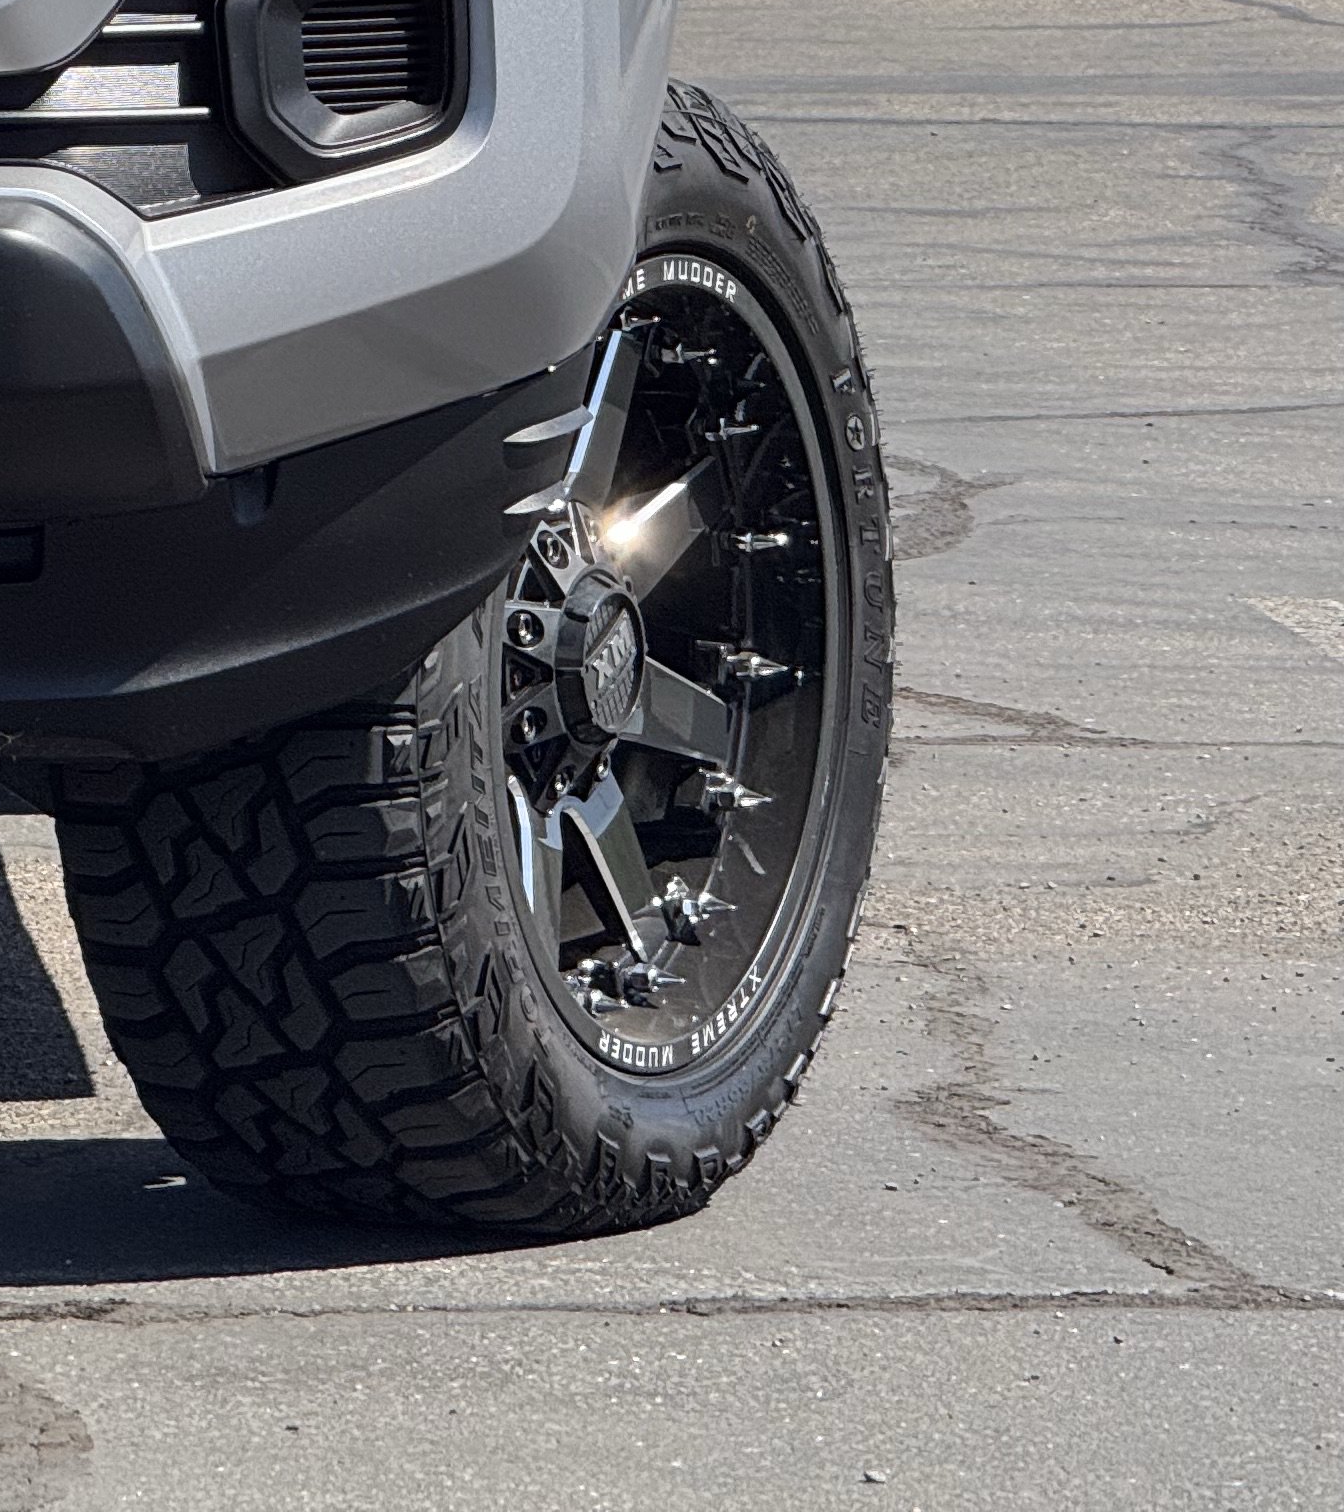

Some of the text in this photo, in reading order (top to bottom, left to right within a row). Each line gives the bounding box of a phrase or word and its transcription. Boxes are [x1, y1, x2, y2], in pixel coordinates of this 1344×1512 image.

[663, 260, 738, 303] MUDDER
[598, 965, 762, 1066] XTREME MUDDER
